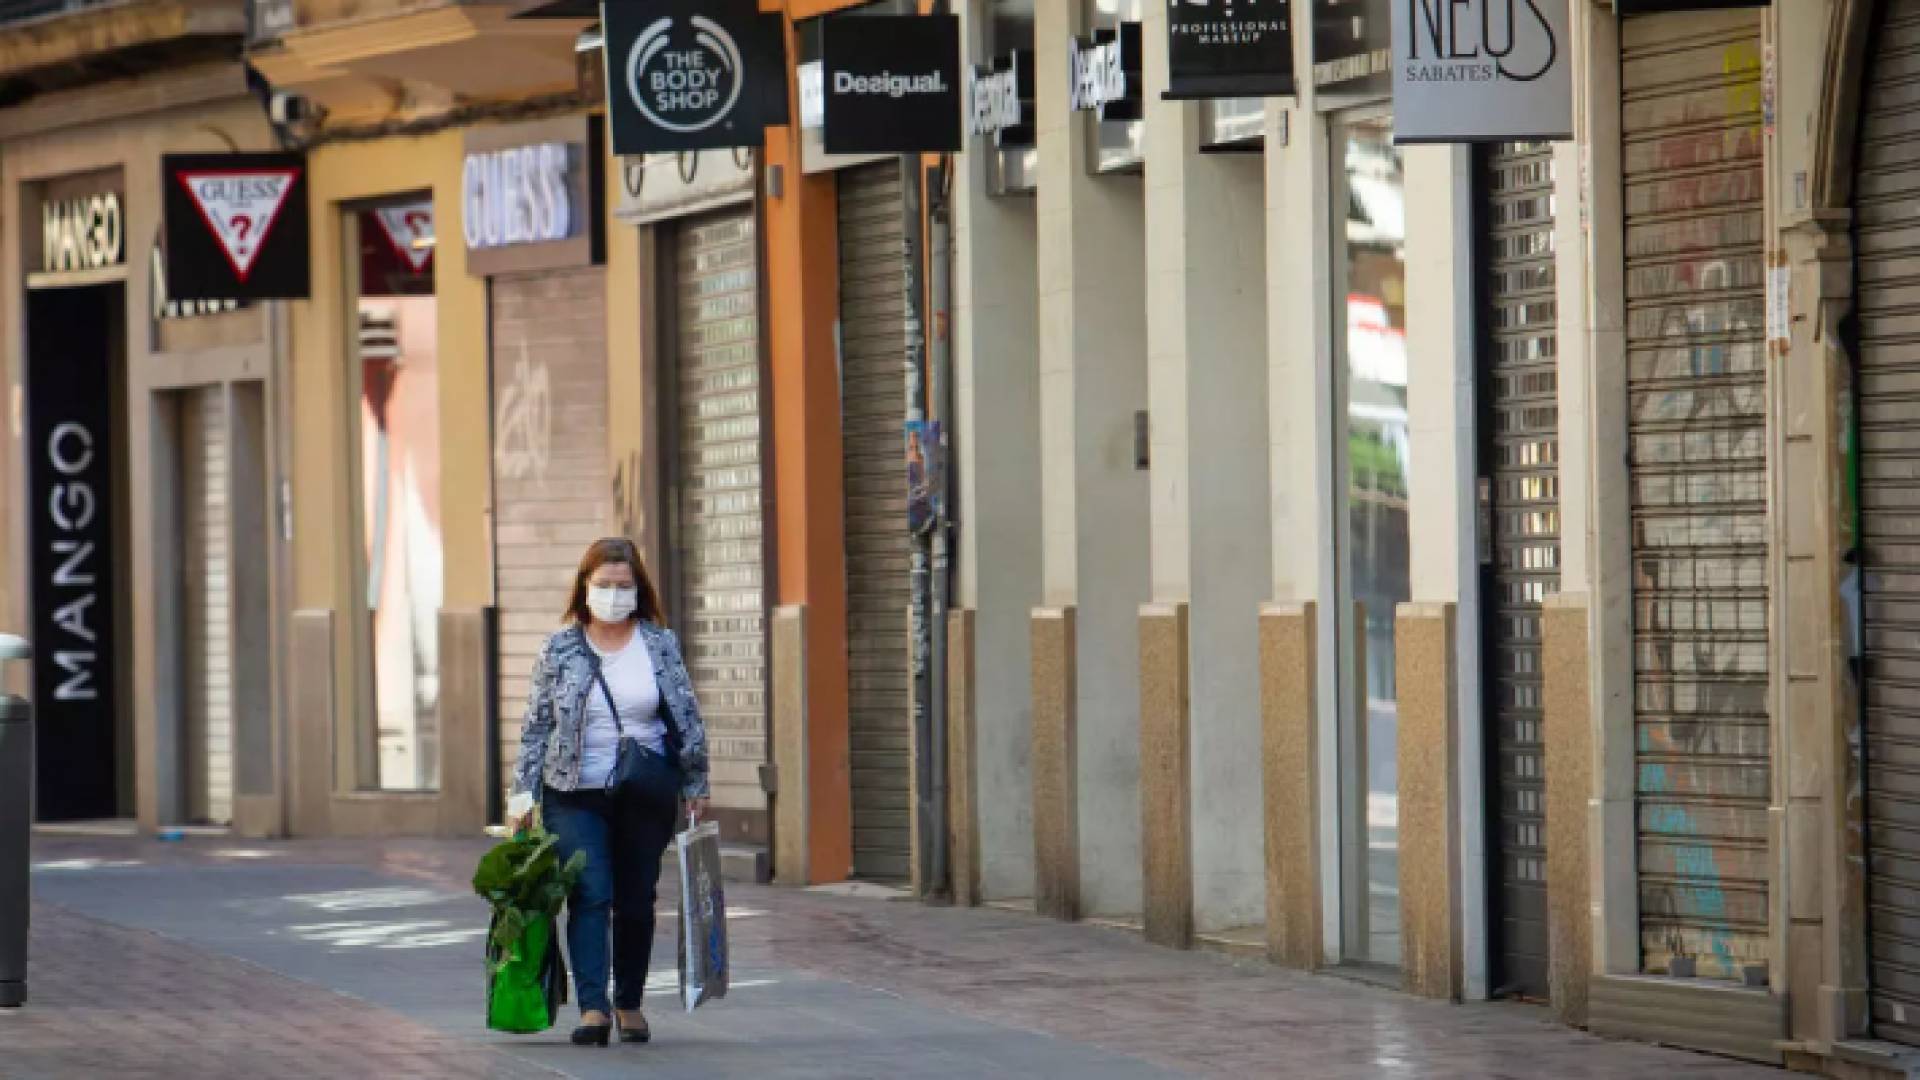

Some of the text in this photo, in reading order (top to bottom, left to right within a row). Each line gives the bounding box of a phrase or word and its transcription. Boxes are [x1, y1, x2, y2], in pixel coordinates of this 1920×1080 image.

[1171, 20, 1287, 34] PROFESSIONAL
[1198, 31, 1261, 44] MAKEUP
[663, 51, 705, 68] THE
[650, 67, 721, 90] BODY
[1406, 64, 1492, 82] SABATES
[655, 89, 719, 111] SHOP
[200, 180, 280, 202] GUESS
[462, 142, 570, 250] GUESS
[42, 191, 121, 273] MANGO
[50, 421, 98, 700] MANGO
